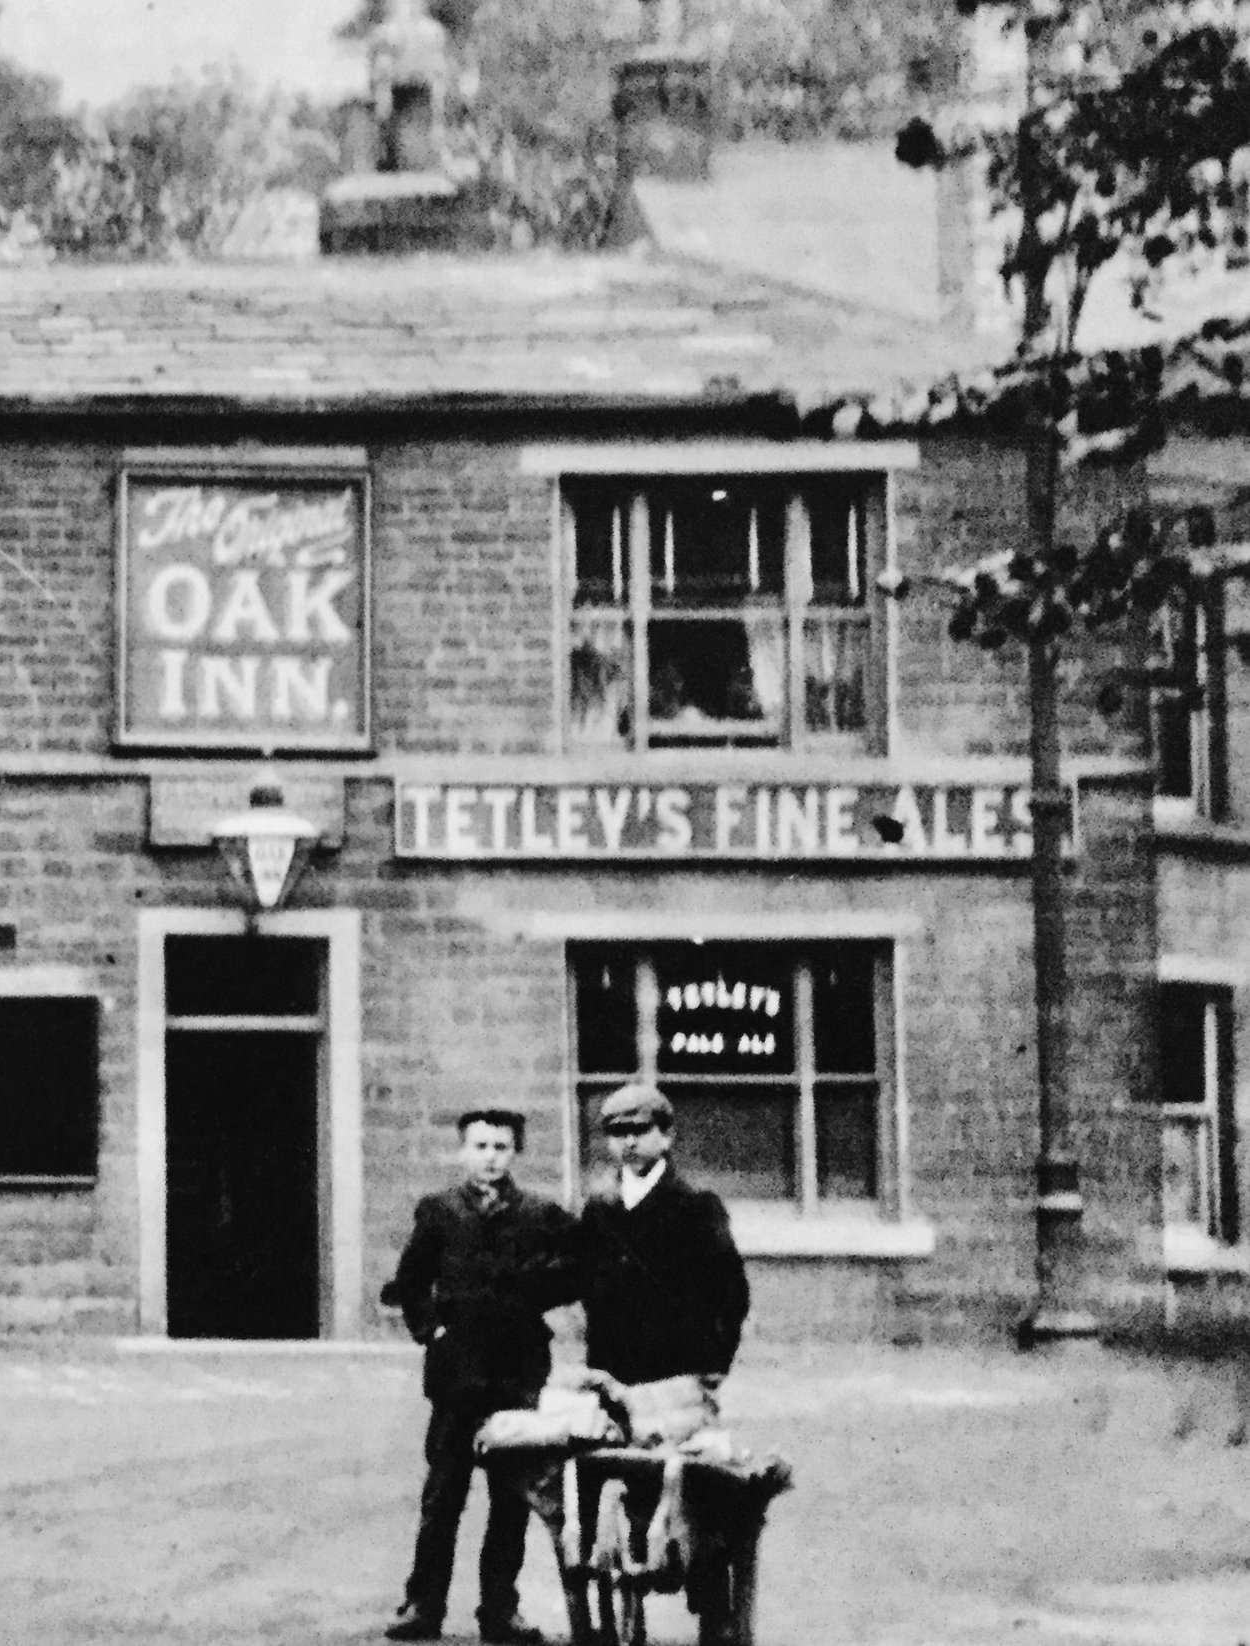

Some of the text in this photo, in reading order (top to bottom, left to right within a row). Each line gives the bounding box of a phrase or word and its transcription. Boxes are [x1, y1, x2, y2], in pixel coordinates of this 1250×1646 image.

[138, 487, 226, 548] The
[148, 564, 353, 642] OAK
[159, 650, 348, 719] INN.
[401, 787, 693, 851] TETLEY'S
[715, 786, 860, 851] FINE
[666, 978, 781, 1018] TETLEY'S
[737, 1031, 776, 1054] ALE
